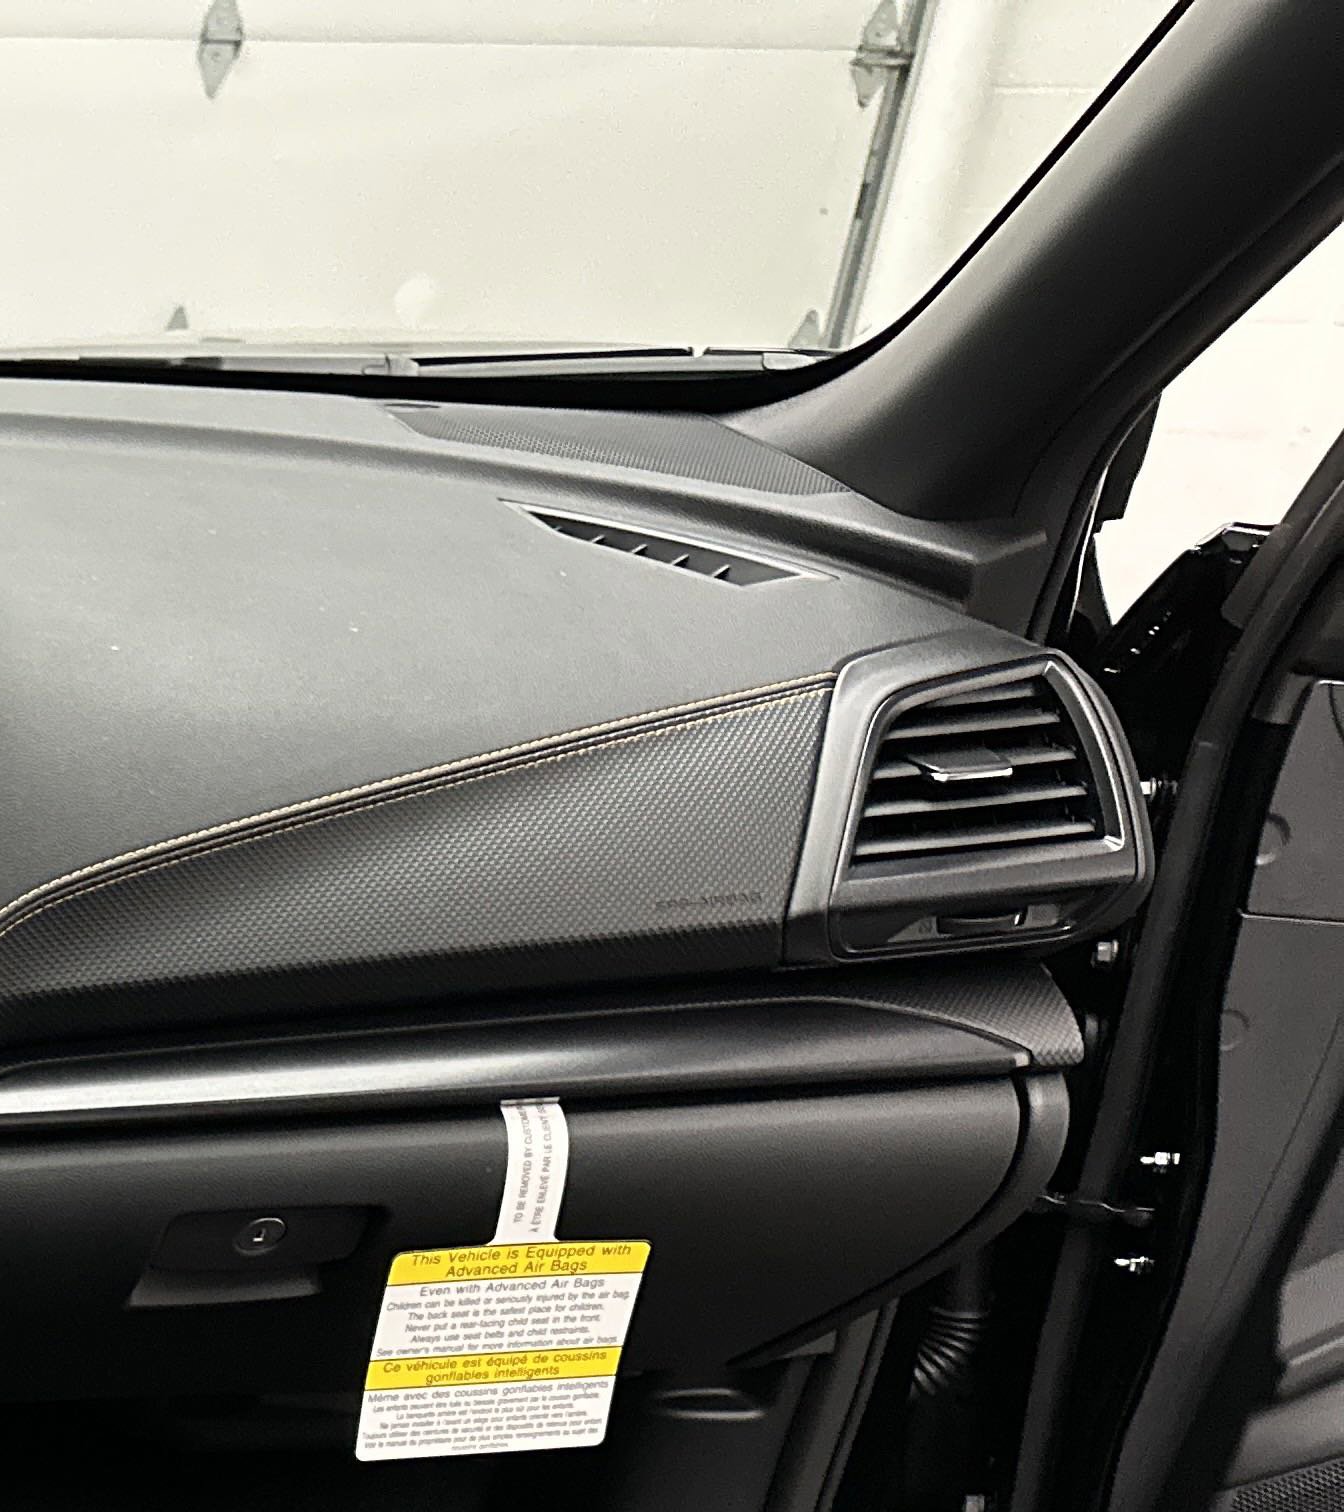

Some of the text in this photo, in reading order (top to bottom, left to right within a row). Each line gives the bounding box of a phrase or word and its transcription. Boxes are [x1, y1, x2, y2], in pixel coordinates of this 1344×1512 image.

[412, 1245, 632, 1267] This Vehicle is Equipped with
[445, 1260, 588, 1278] Advanced Air Bags
[419, 1278, 605, 1297] Even with Advanced Air Bags
[383, 1351, 608, 1373] Ce véhicule est équipé de coussins
[425, 1366, 560, 1386] gonflables intelligents
[403, 1392, 428, 1401] avec
[431, 1390, 451, 1399] des
[454, 1388, 498, 1398] coussins
[502, 1384, 553, 1396] gonflables
